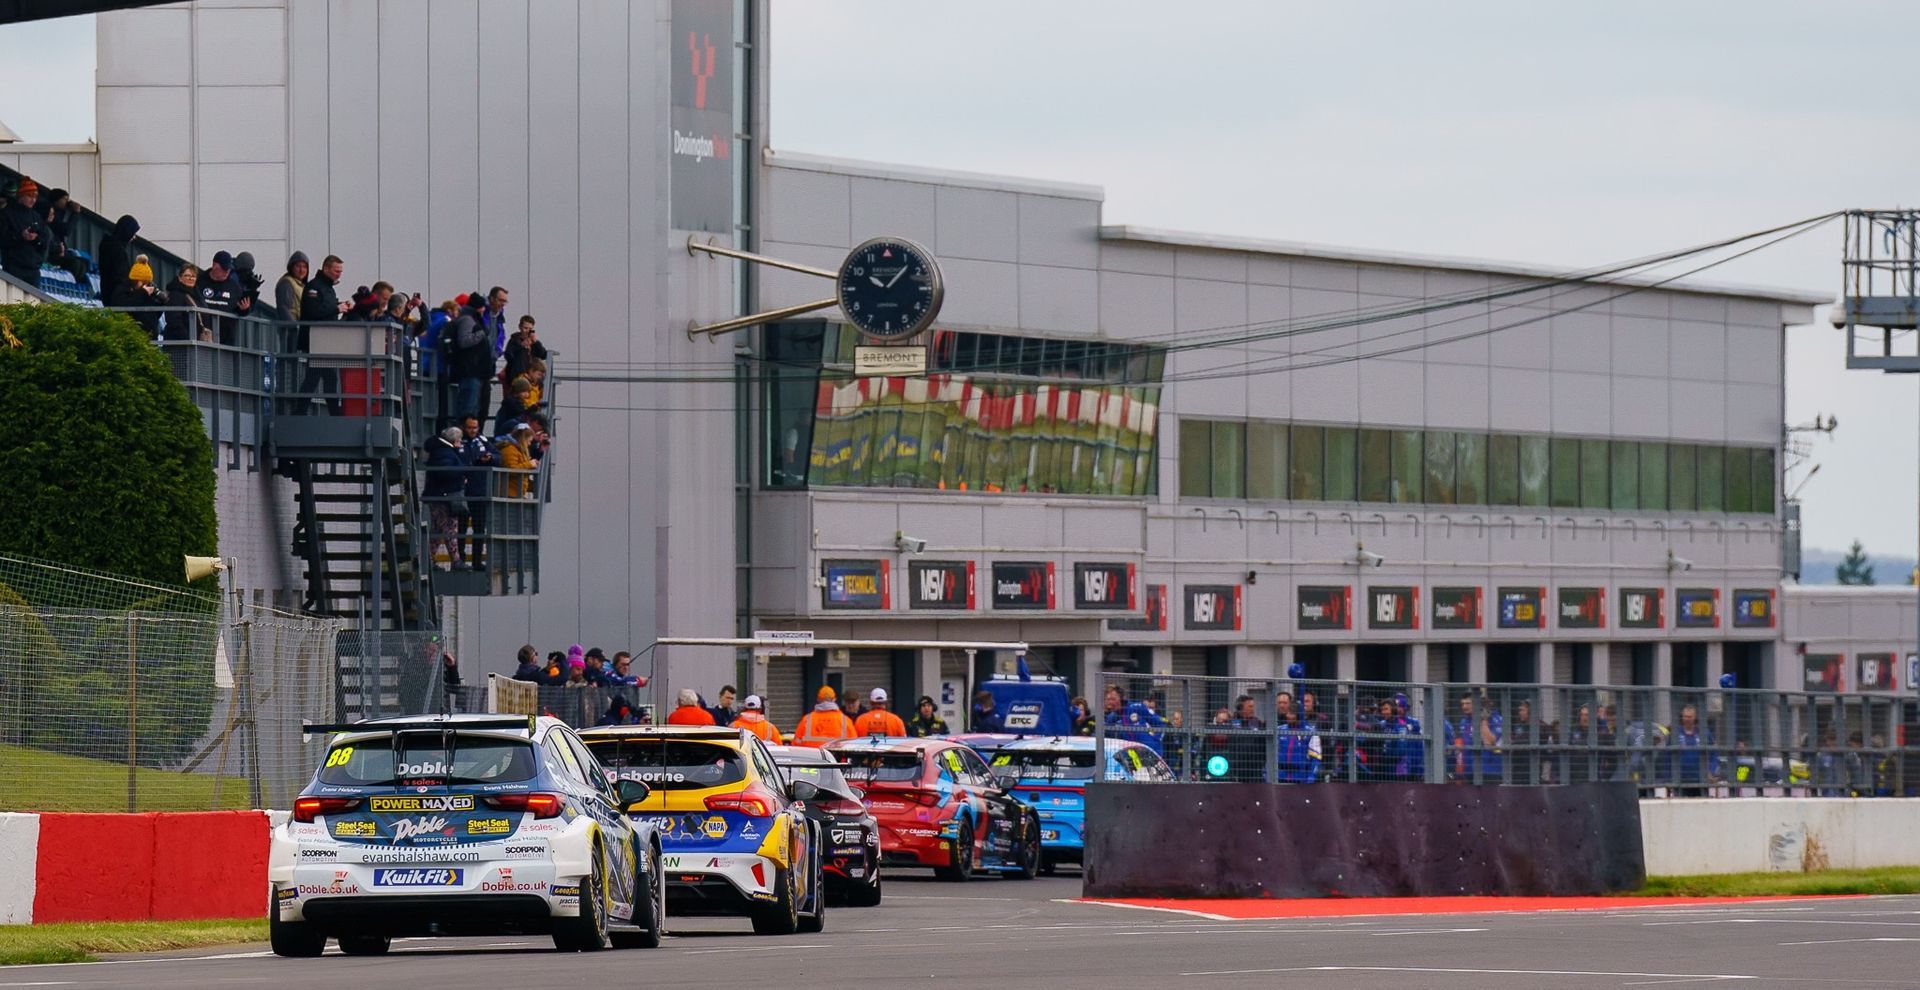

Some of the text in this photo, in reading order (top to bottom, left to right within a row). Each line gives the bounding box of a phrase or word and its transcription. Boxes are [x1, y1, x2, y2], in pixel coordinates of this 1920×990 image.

[853, 267, 864, 276] 10
[915, 267, 921, 276] 2
[853, 301, 860, 311] 8
[914, 302, 920, 310] 4
[867, 314, 873, 323] 7
[902, 314, 908, 323] 5
[863, 353, 919, 362] BREMONT
[920, 569, 945, 600] MSV
[1084, 571, 1108, 601] MSV
[1193, 593, 1217, 622] MSV
[1376, 594, 1397, 622] MSV
[326, 747, 353, 768] 88
[993, 755, 1011, 767] 29
[398, 762, 454, 775] Doble
[373, 796, 472, 810] POWER MAXED
[336, 821, 376, 830] Steel Seal
[468, 818, 509, 828] Steel Seal
[708, 822, 724, 831] NAPA
[387, 816, 449, 845] Doble
[301, 849, 338, 857] SCORPION
[505, 846, 545, 854] SCORPION
[362, 851, 480, 863] evanshalshaw.com
[379, 869, 451, 886] KwikFit
[299, 884, 359, 894] Doble.co.uk
[482, 880, 547, 892] Doble.co.uk
